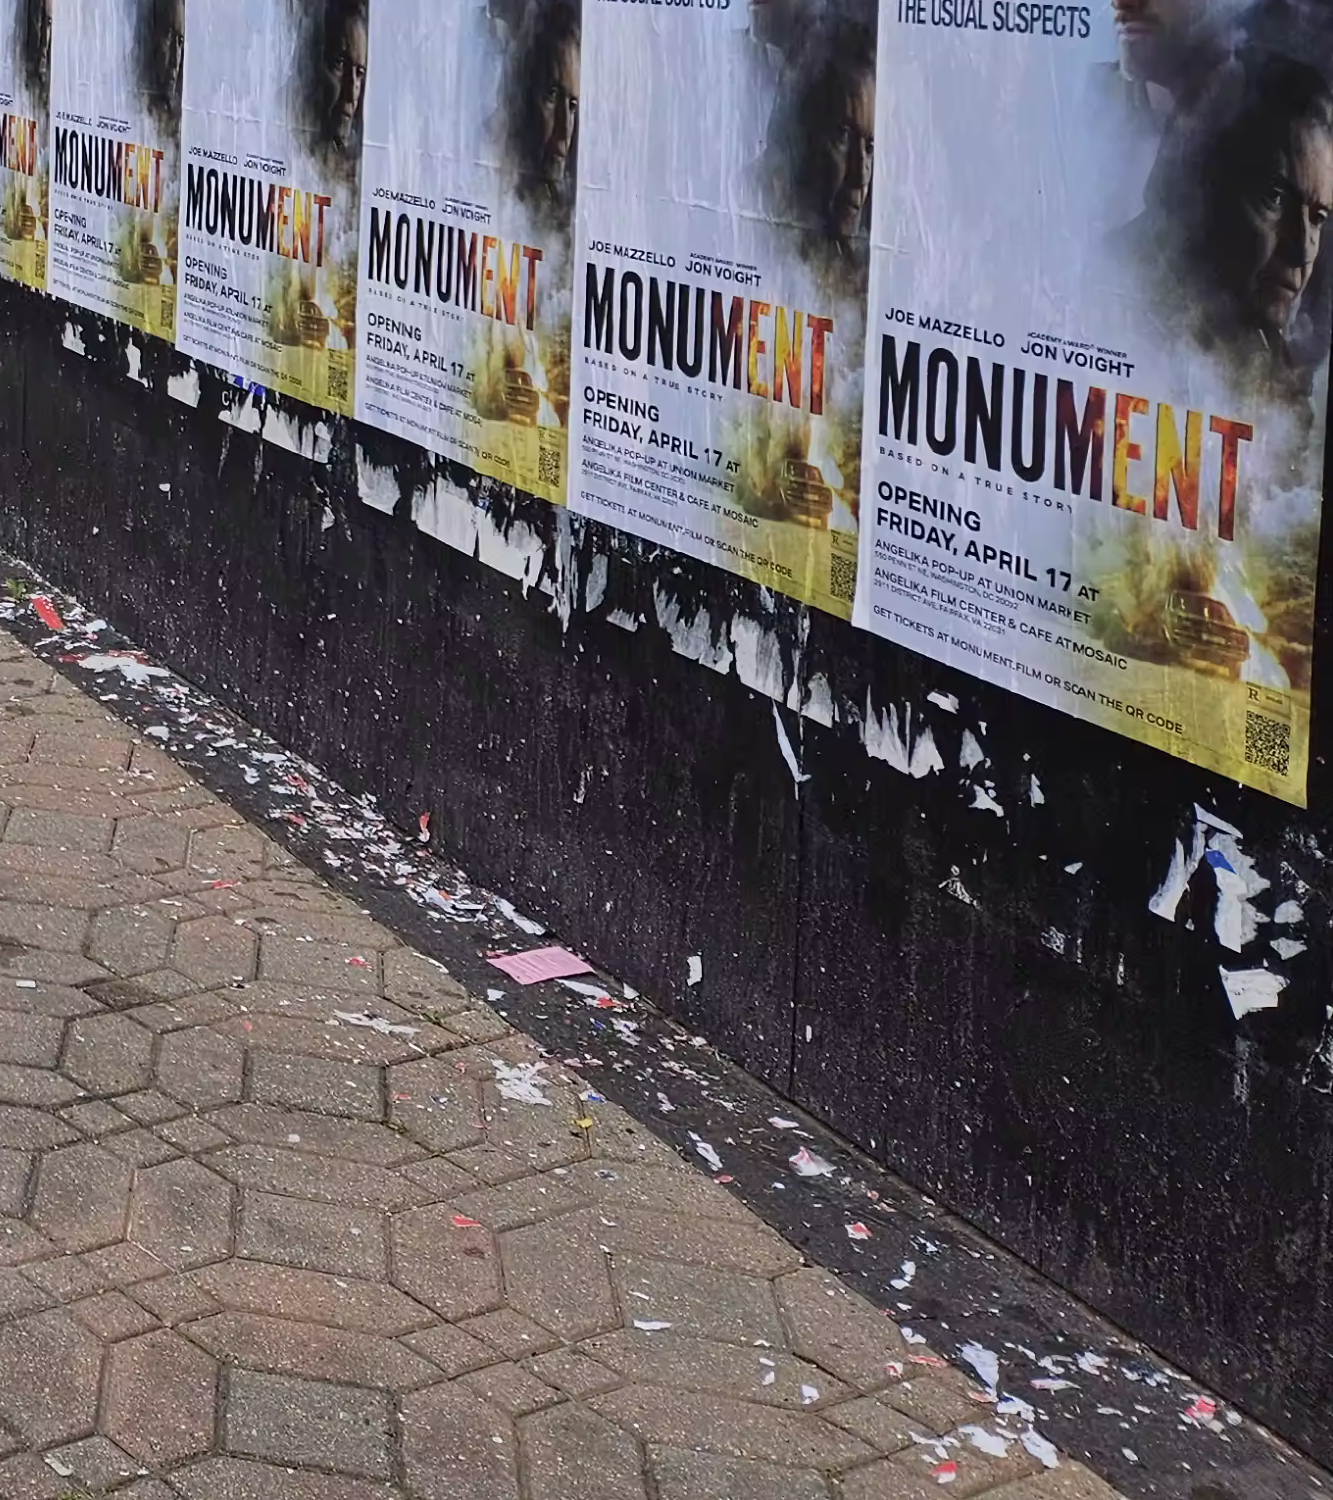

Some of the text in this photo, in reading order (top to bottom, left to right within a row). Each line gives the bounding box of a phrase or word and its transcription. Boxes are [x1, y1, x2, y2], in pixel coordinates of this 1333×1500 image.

[993, 1, 1090, 38] SUSPECTS
[54, 126, 164, 214] MONUMENT
[186, 163, 331, 267] MONUMENT
[368, 207, 543, 330] MONUMENT
[589, 240, 675, 268] JOE MAZZELLO
[685, 259, 711, 275] JON
[367, 313, 422, 342] OPENING
[584, 263, 833, 415] MONUMENT
[885, 308, 1005, 348] JOE MAZZELLO
[1021, 341, 1135, 379] JON VOIGHT
[584, 386, 659, 422] OPENING
[583, 408, 643, 443] FRIDAY,
[648, 431, 699, 460] APRIL
[704, 448, 722, 467] 17
[726, 461, 741, 474] AT
[879, 334, 1253, 541] MONUMENT
[879, 447, 922, 467] BASED
[931, 463, 950, 476] ON
[958, 471, 965, 481] A
[975, 476, 1013, 495] TRUE
[878, 481, 981, 531] OPENING
[876, 539, 1091, 625] ANGELIKA POP-UP AT UNION MARKET
[877, 509, 1100, 601] FRIDAY, APRIL 17 AT
[875, 567, 928, 597] ANGELIKA
[931, 588, 956, 607] FILM
[959, 598, 1006, 626] CENTER
[1008, 615, 1016, 629] &
[1020, 619, 1053, 643] CAFE
[1056, 632, 1071, 650] AT
[1073, 639, 1127, 670] MOSAIC
[873, 605, 1183, 734] GET TICKETS AT MONUMENT.FILM OR SCAN THE QR CODE
[1249, 688, 1260, 701] R
